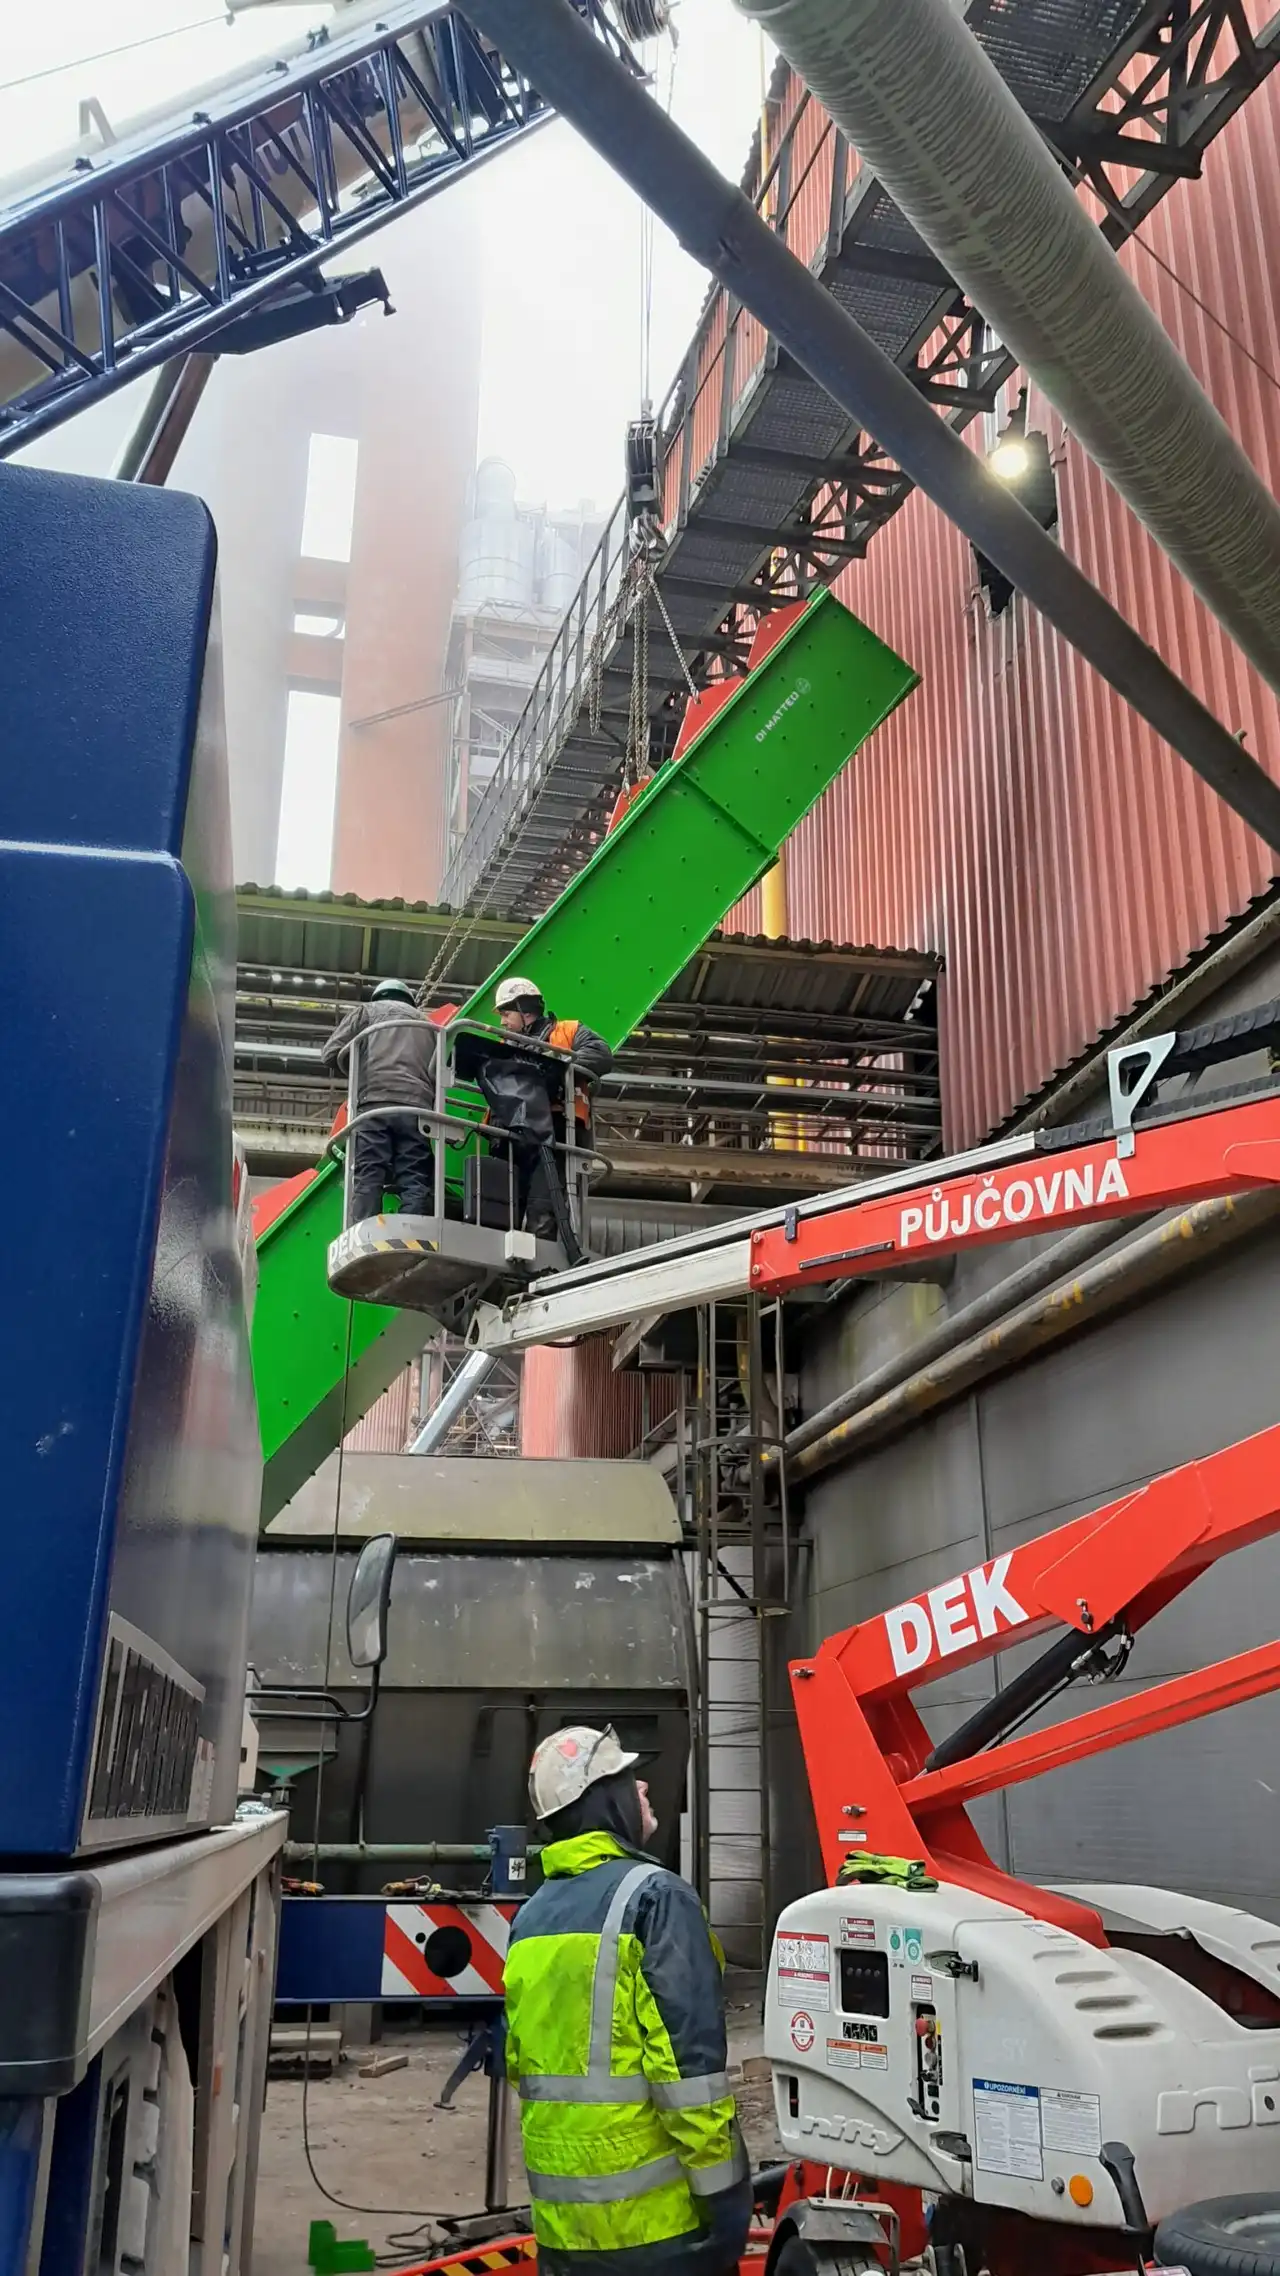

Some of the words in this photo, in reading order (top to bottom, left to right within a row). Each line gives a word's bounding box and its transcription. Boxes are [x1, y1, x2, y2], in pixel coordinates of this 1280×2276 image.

[755, 729, 767, 743] DI
[765, 691, 799, 731] MATTEO
[901, 1158, 1129, 1247] PŮJČOVNA
[329, 1222, 363, 1263] DEK
[884, 1552, 1029, 1677] DEK
[801, 2114, 906, 2156] nifty
